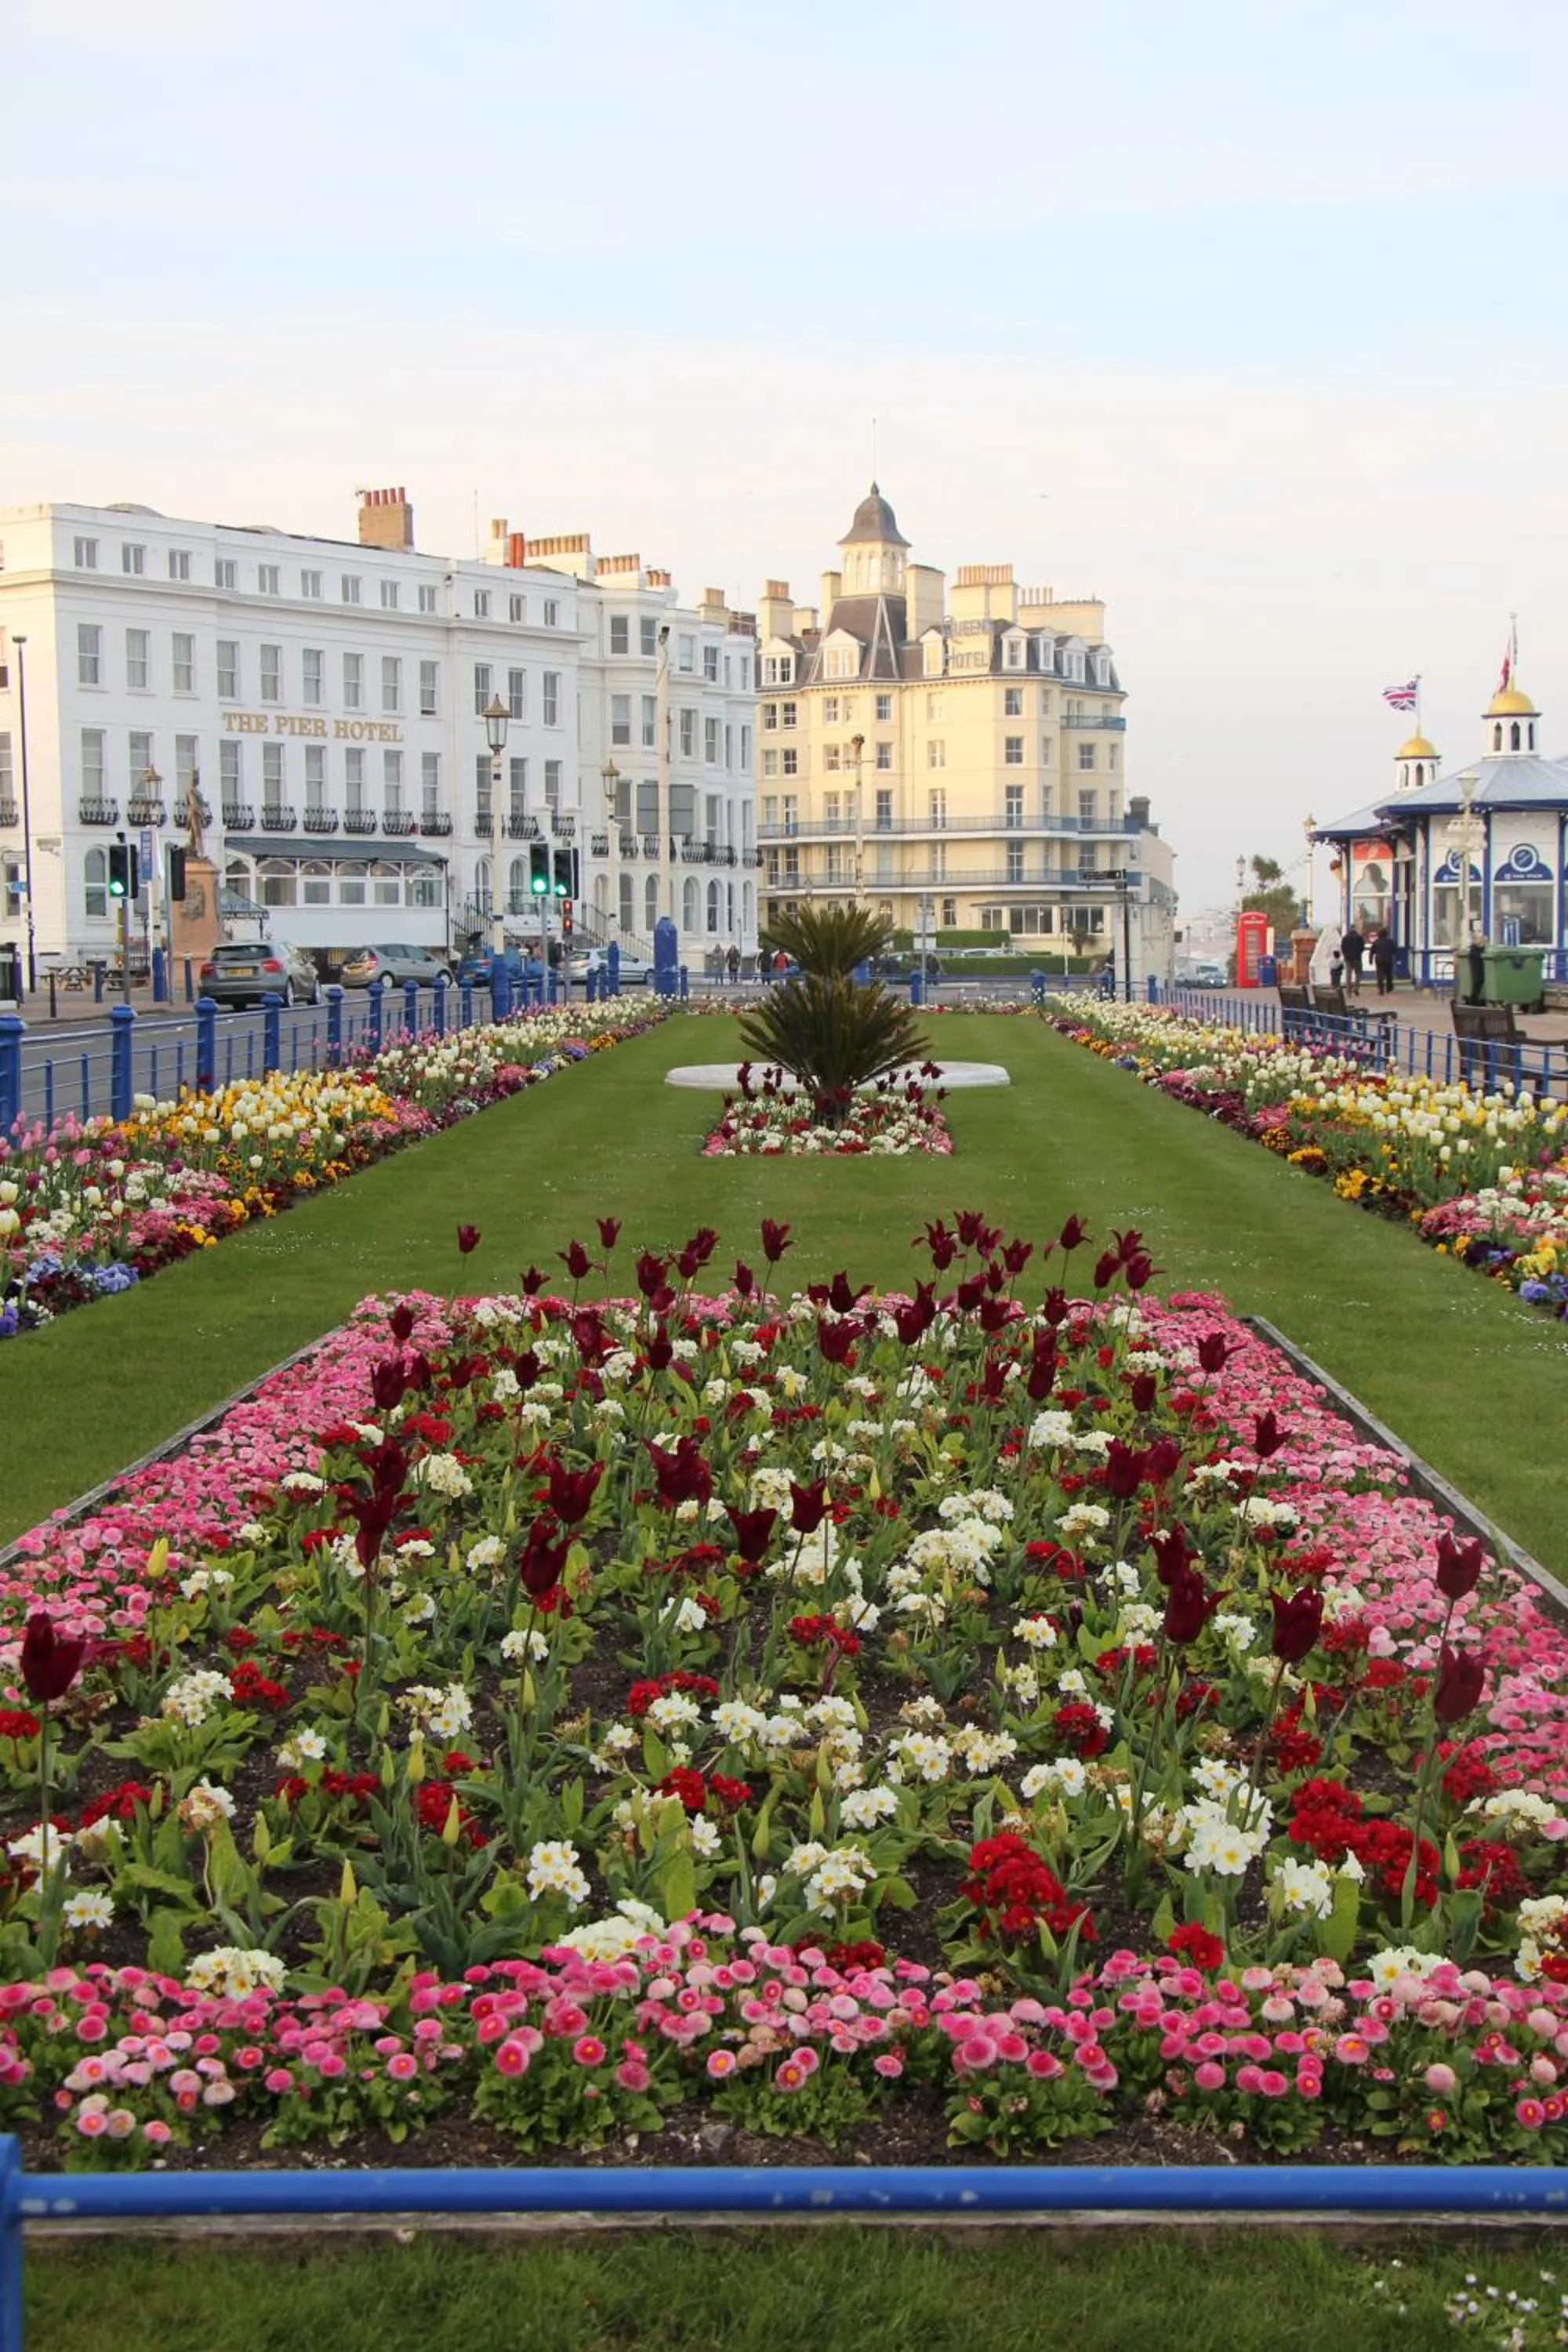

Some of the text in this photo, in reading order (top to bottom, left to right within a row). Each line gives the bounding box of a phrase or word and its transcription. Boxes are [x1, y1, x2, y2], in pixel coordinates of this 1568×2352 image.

[942, 647, 989, 670] HOTEL
[223, 713, 403, 742] THE PIER HOTEL
